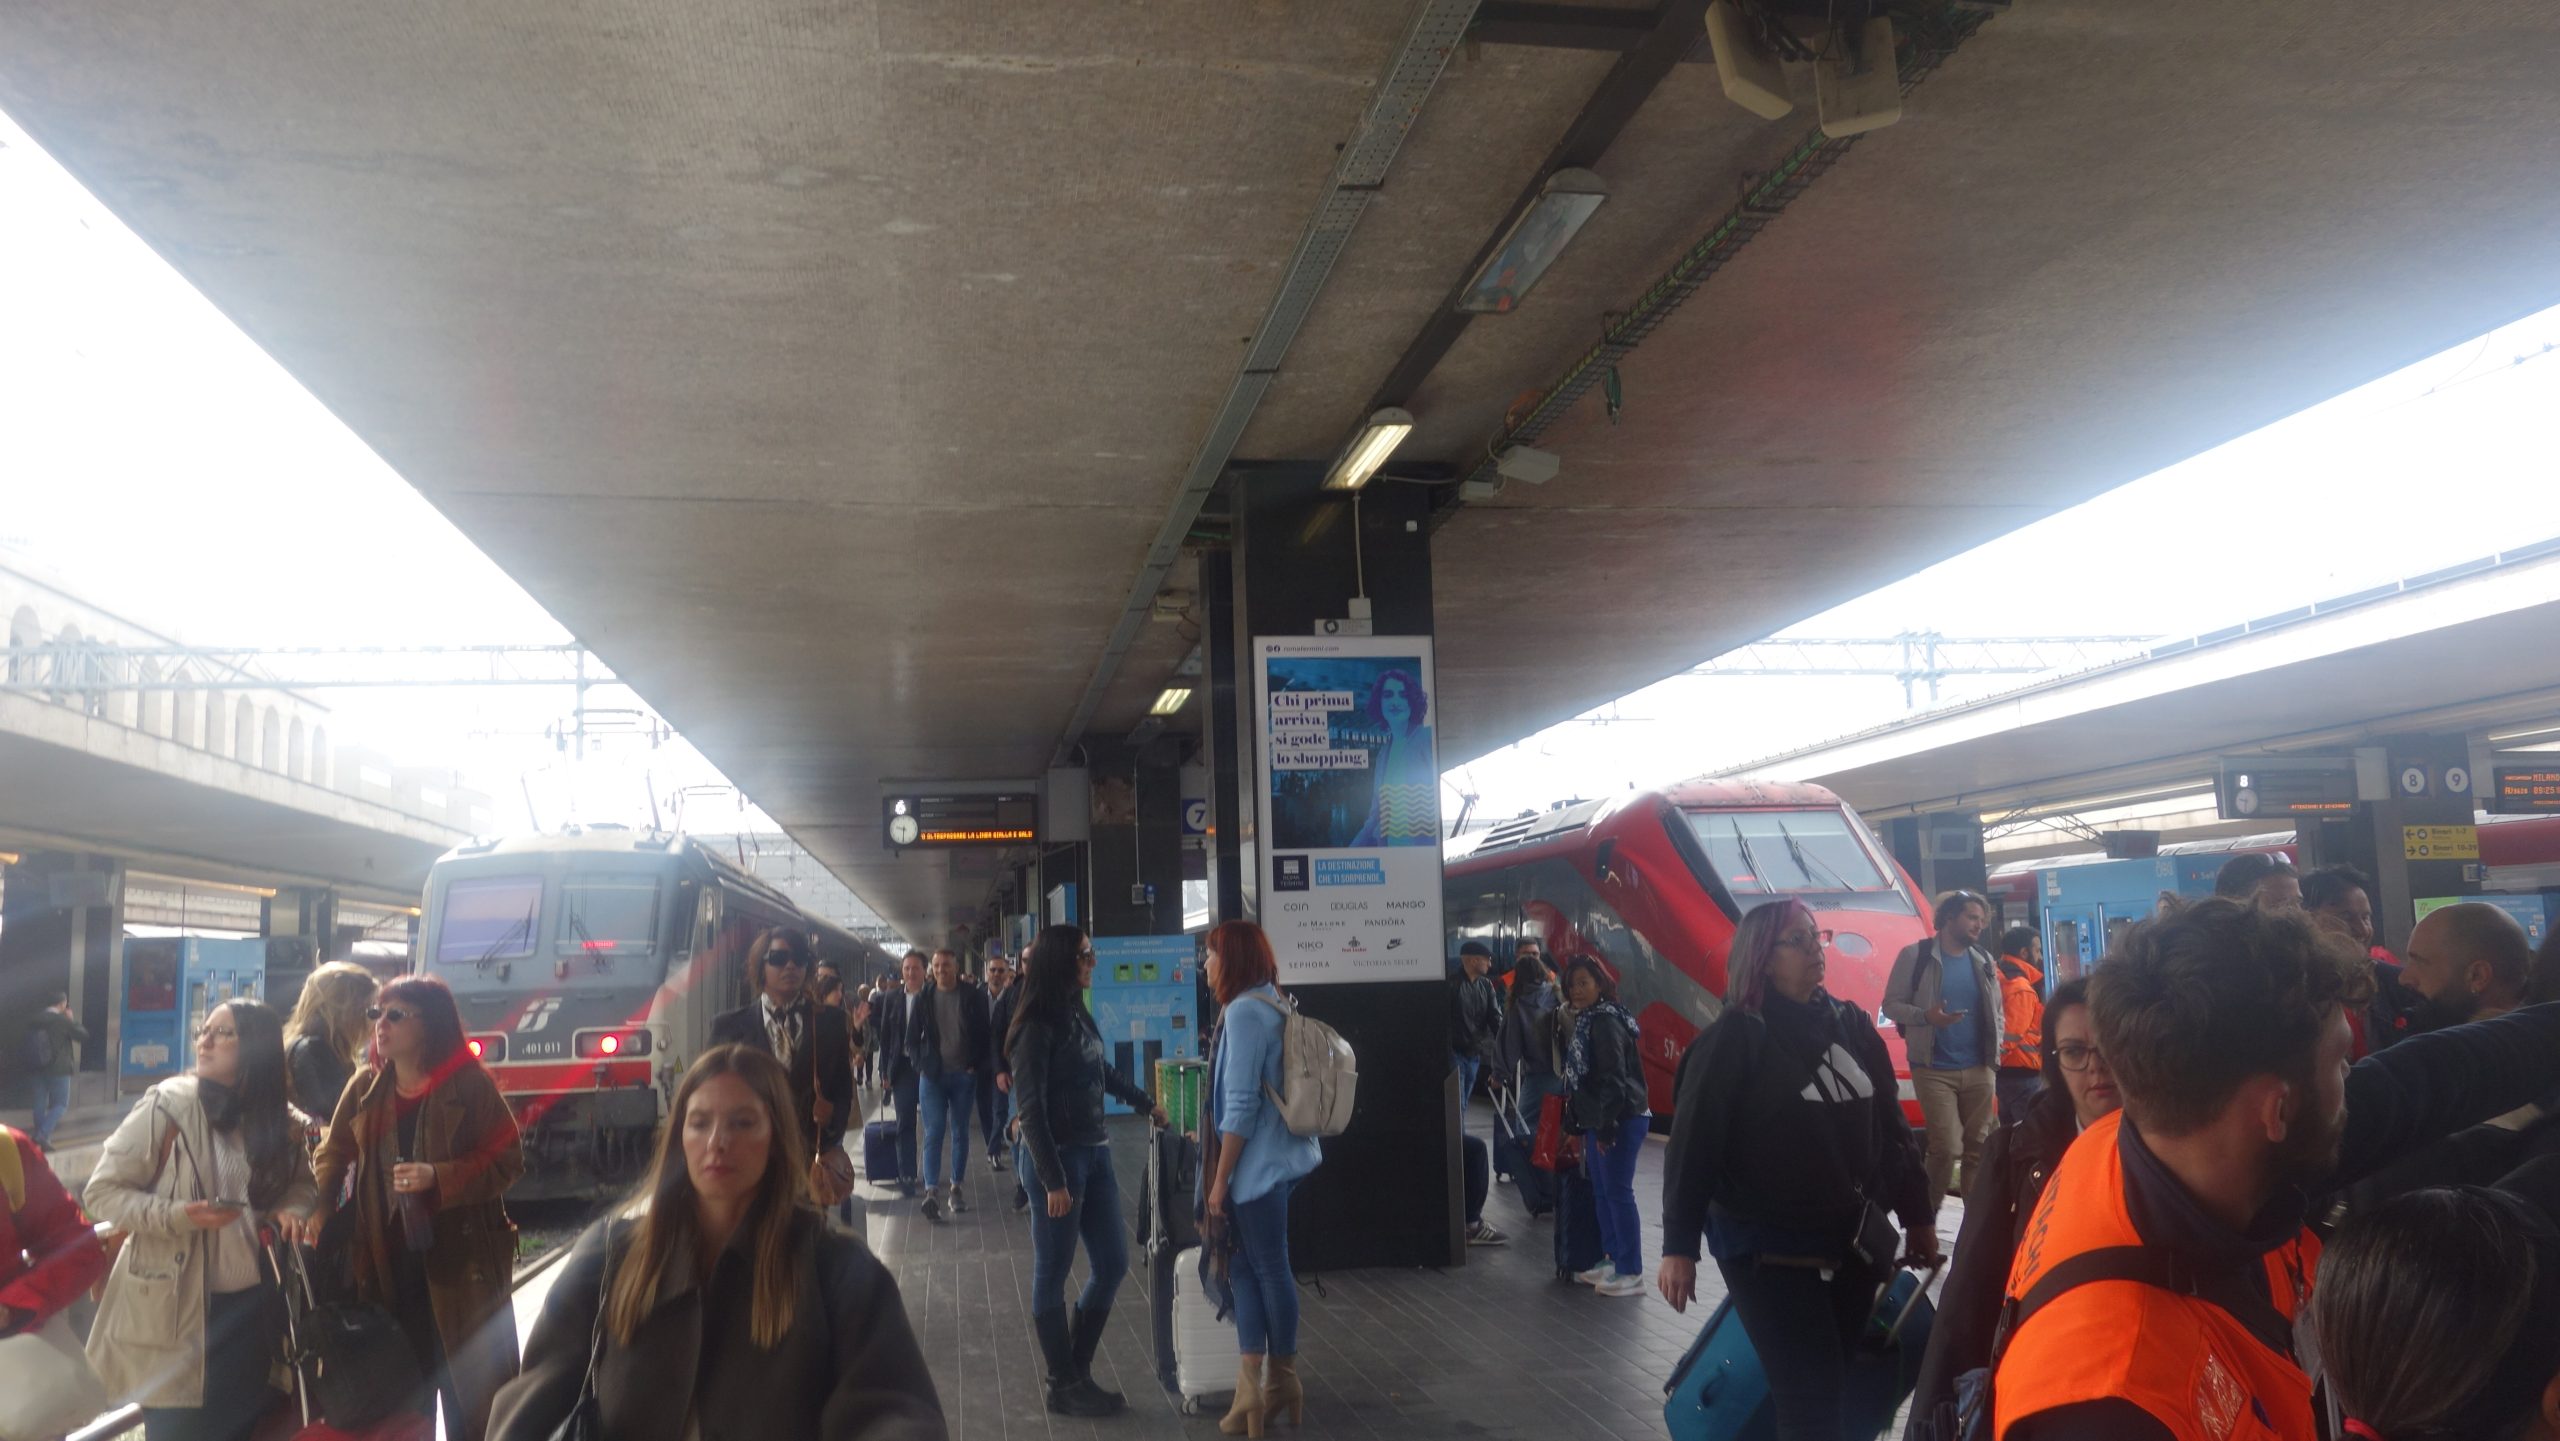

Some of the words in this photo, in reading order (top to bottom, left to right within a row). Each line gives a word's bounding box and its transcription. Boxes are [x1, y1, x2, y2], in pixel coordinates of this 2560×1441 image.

[1274, 693, 1300, 707] Chi
[1304, 693, 1350, 710] prima
[1275, 713, 1325, 727] arriva,
[1275, 732, 1287, 745] si
[1291, 732, 1326, 747] gode
[1276, 752, 1290, 765] lo
[1293, 751, 1367, 767] shopping.
[2239, 774, 2249, 788] 8
[2409, 774, 2418, 787] 8
[2452, 773, 2461, 786] 9
[1194, 809, 1206, 824] 7
[1317, 860, 1327, 871] LA
[1327, 859, 1376, 870] DESTINAZIONE
[1318, 873, 1332, 884] CHE
[1333, 873, 1340, 883] TI
[1330, 901, 1368, 911] DOUGLAS
[1386, 900, 1426, 910] MANGO
[1297, 941, 1324, 950] KIKO
[1288, 960, 1331, 969] SEPHORA
[544, 1041, 561, 1054] 011
